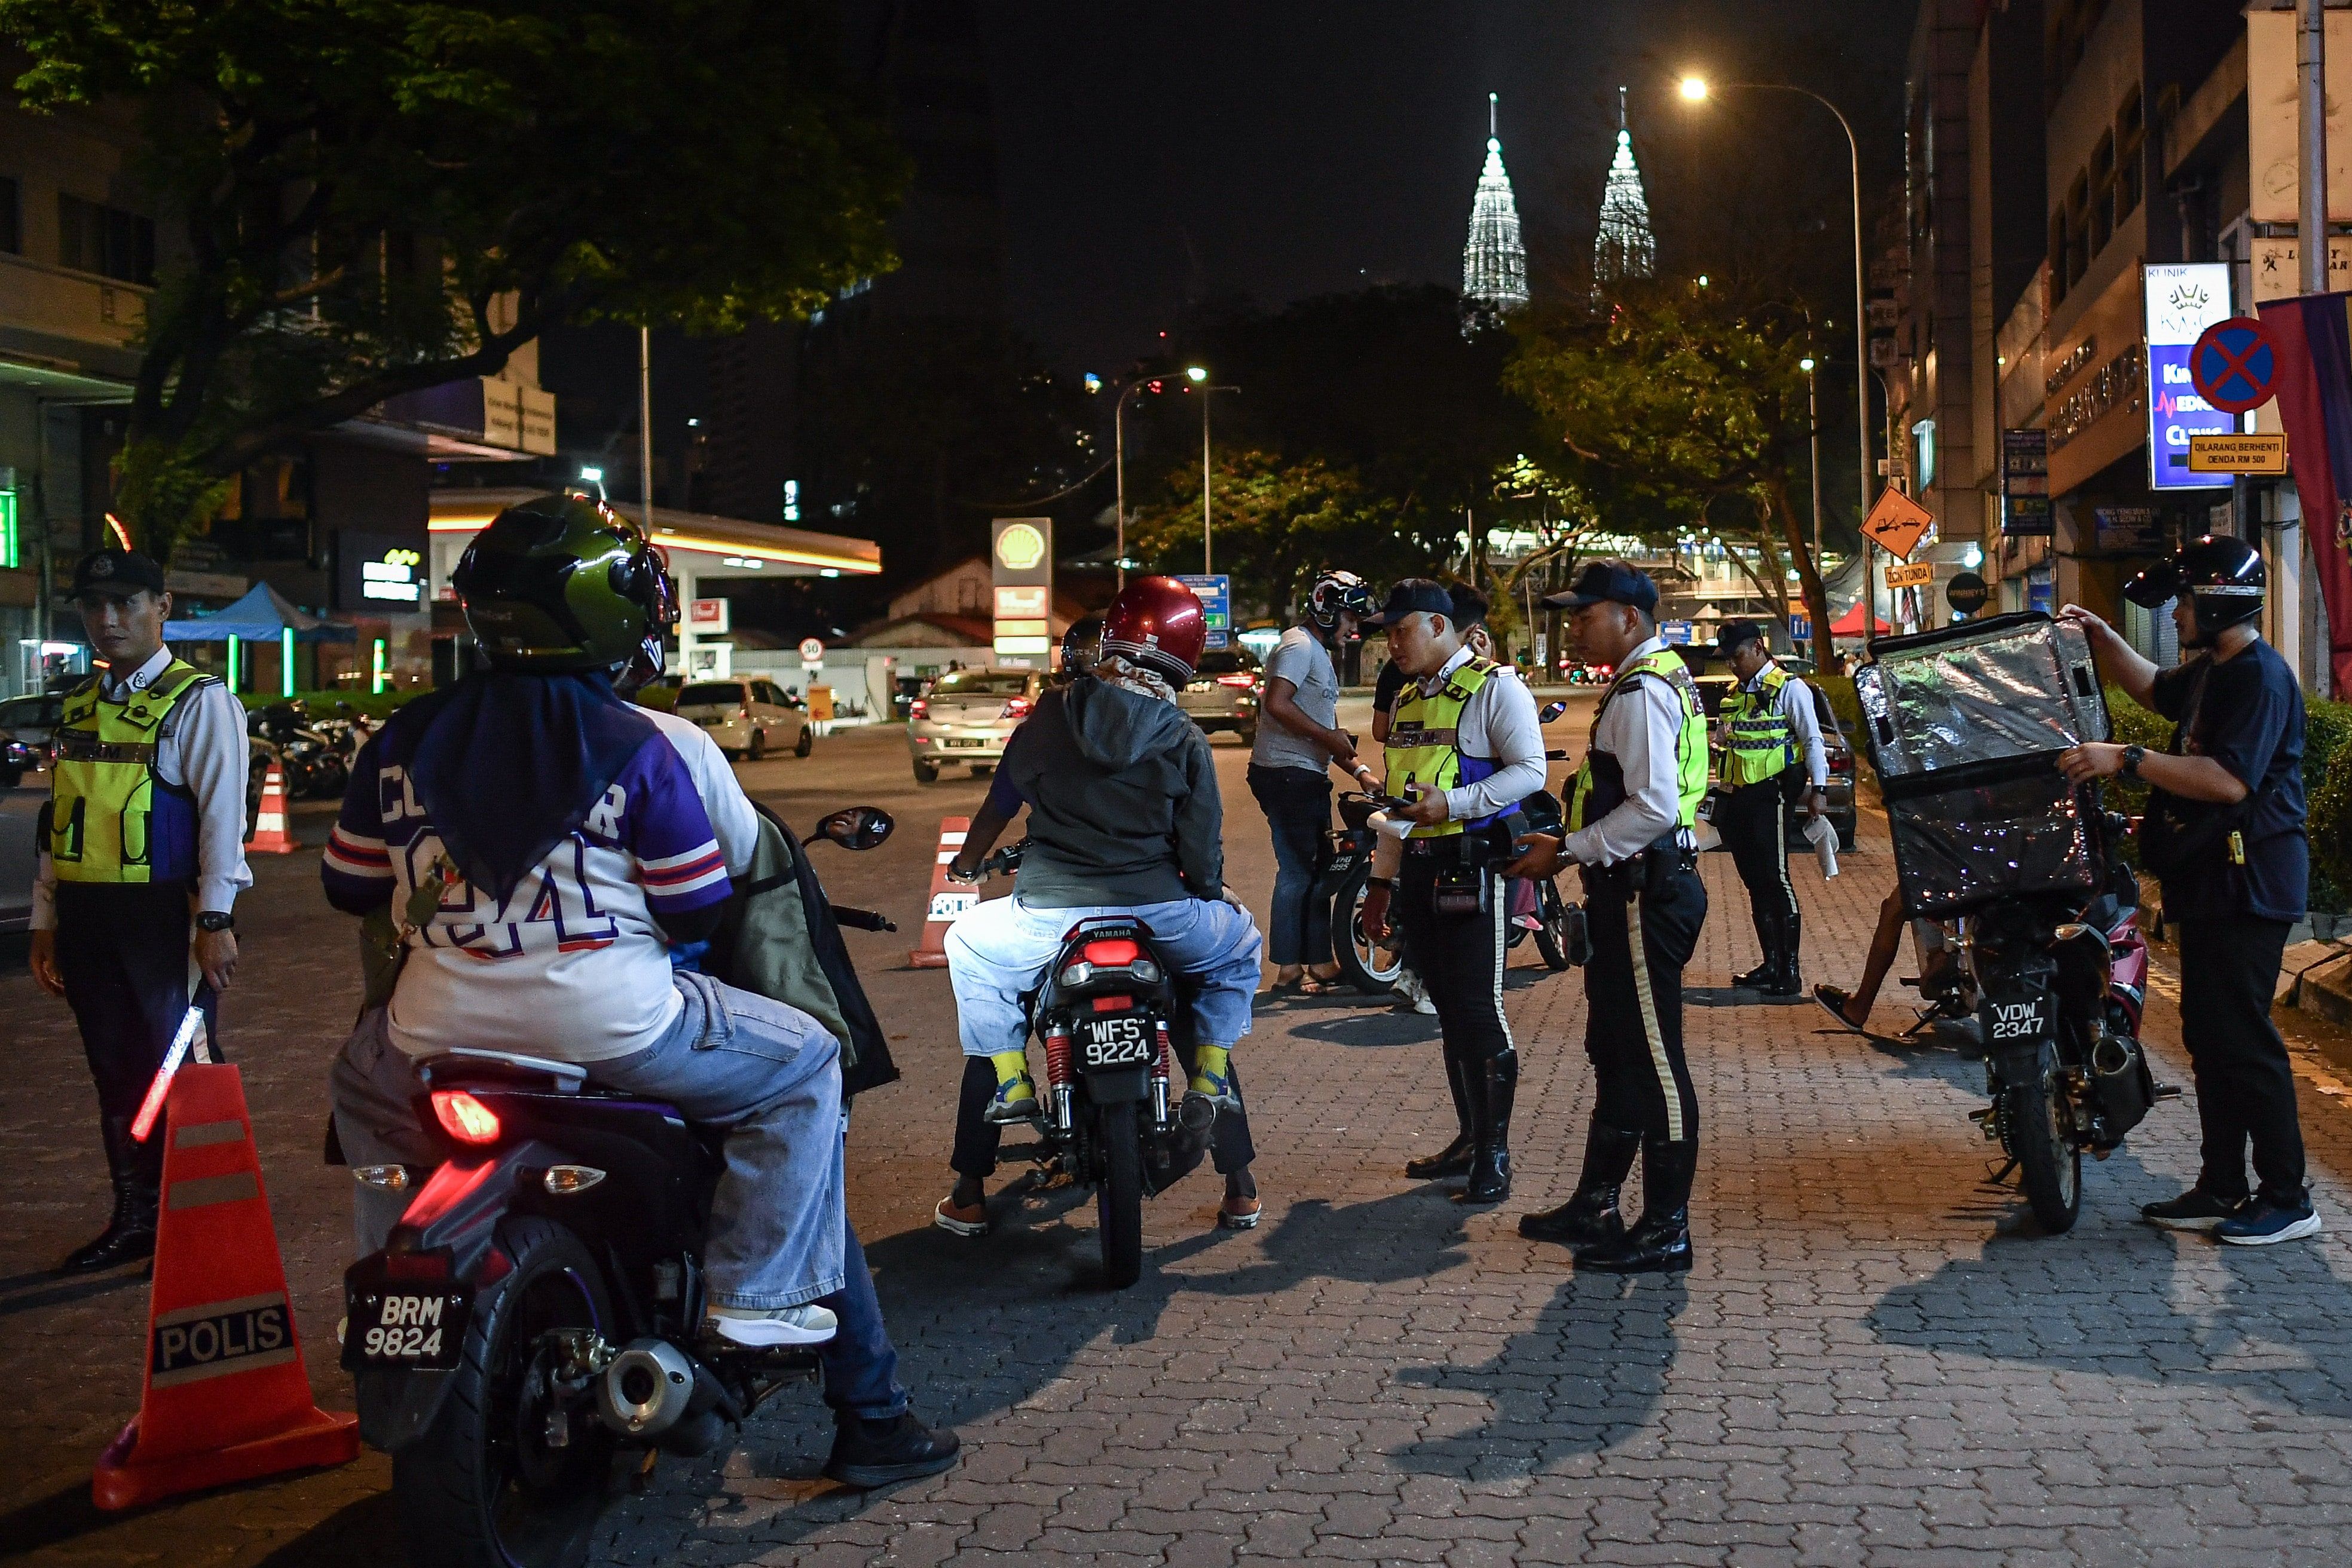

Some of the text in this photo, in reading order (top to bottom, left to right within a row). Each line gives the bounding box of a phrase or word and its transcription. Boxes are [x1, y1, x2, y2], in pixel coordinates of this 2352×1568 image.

[2195, 443, 2278, 452] DILARANG BERHENTI
[1888, 568, 1928, 583] ZON TUNDA
[1093, 929, 1131, 938] YAMAHA
[1996, 1002, 2035, 1022] VDW
[1091, 1018, 1140, 1043] WFS
[1992, 1016, 2044, 1039] 2347
[1086, 1039, 1150, 1065] 9224
[380, 1296, 444, 1326] BRM
[161, 1309, 283, 1368] POLIS
[364, 1327, 441, 1356] 9824
